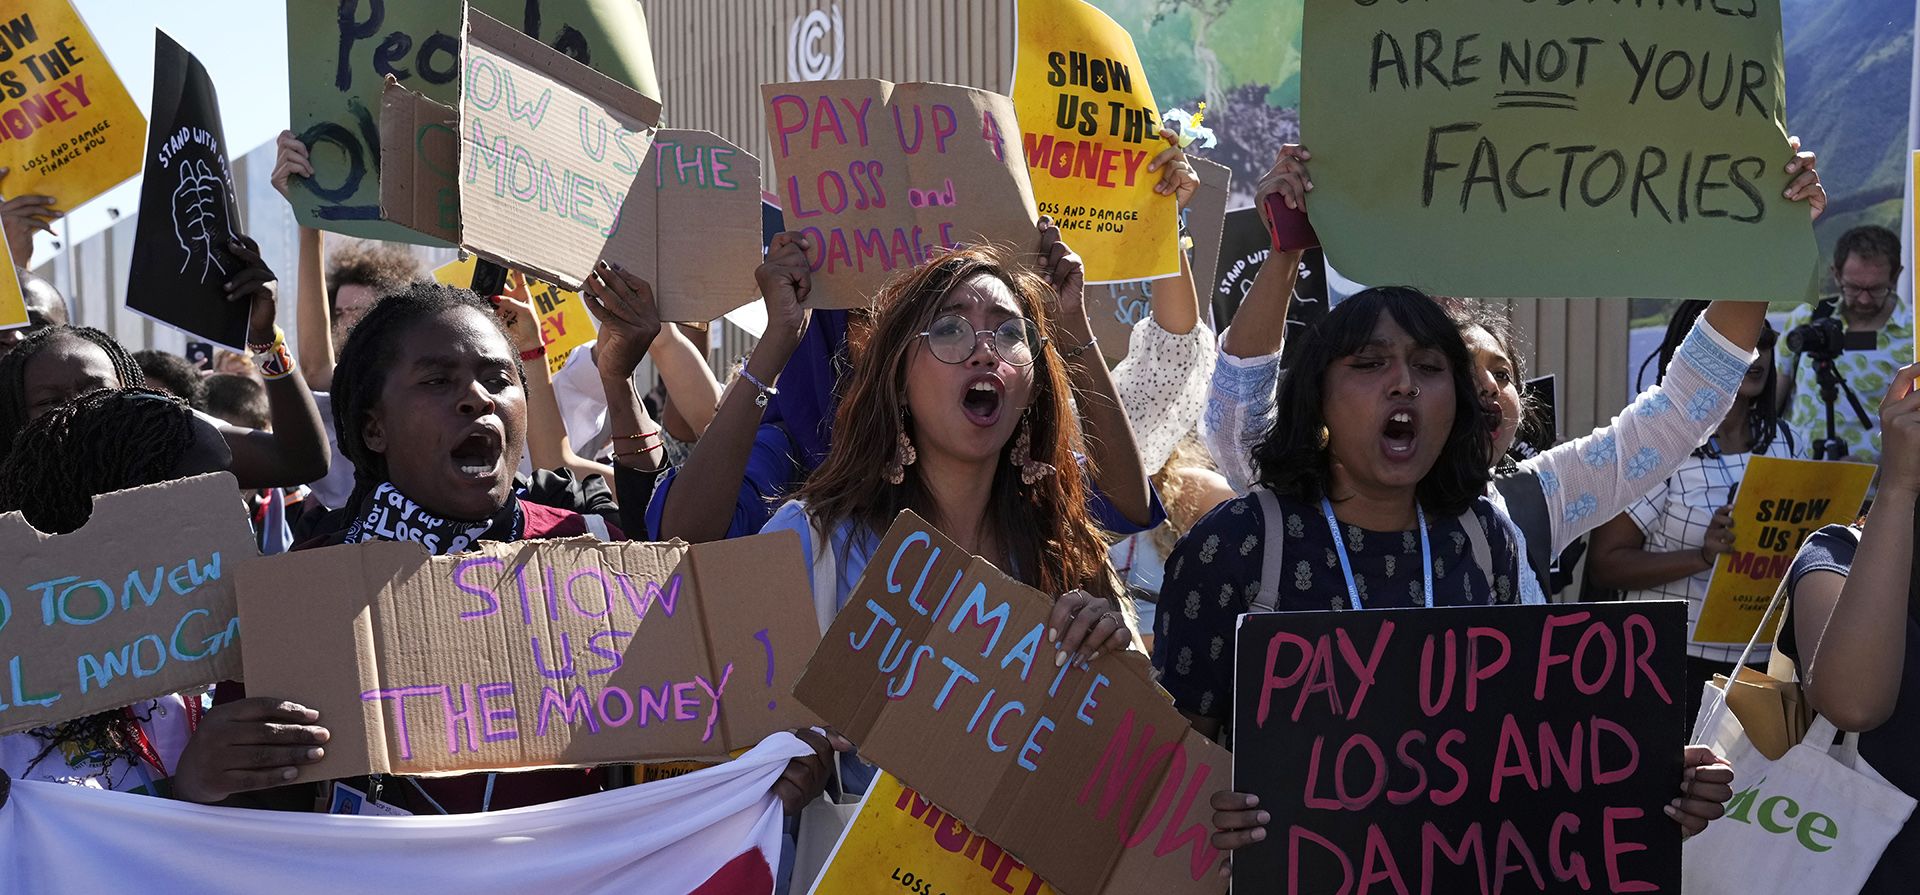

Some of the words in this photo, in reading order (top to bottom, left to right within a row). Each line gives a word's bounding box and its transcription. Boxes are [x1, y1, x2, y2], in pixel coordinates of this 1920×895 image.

[19, 36, 84, 84] THE
[1047, 51, 1132, 94] SHOW
[1369, 29, 1482, 93] ARE
[1500, 37, 1605, 88] NOT
[1619, 38, 1769, 119] YOUR
[771, 94, 872, 158] PAY
[893, 104, 957, 155] UP
[1056, 93, 1099, 136] US
[1107, 101, 1160, 144] THE
[22, 154, 48, 172] LOSS
[51, 144, 69, 158] AND
[71, 120, 111, 146] DAMAGE
[40, 148, 82, 176] FINANCE
[85, 136, 106, 154] NOW
[159, 127, 190, 168] STAND
[193, 127, 217, 154] WITH
[579, 106, 640, 175] US
[651, 141, 738, 190] THE
[1023, 132, 1148, 188] MONEY
[1421, 121, 1766, 224] FACTORIES
[466, 116, 624, 238] MONEY
[787, 160, 886, 218] LOSS
[908, 178, 957, 208] and
[1038, 202, 1059, 214] OSS
[1063, 205, 1086, 217] AND
[1090, 209, 1138, 221] DAMAGE
[1053, 217, 1092, 230] NANCE
[1096, 222, 1124, 233] NOW
[1219, 259, 1246, 295] STAND
[1247, 249, 1270, 265] WIT
[535, 286, 566, 315] HE
[363, 504, 382, 531] for
[375, 507, 441, 556] Loss
[374, 482, 421, 521] Pay
[417, 511, 444, 530] up
[1756, 499, 1831, 524] SHOW
[1727, 551, 1795, 581] MON
[1757, 526, 1791, 552] US
[26, 575, 116, 626] TO
[121, 552, 221, 611] NEW
[453, 556, 682, 625] SHOW
[531, 631, 633, 679] US
[887, 531, 1110, 726] CLIMATE
[77, 634, 167, 694] AND
[849, 599, 1056, 772] JUSTICE
[1257, 619, 1395, 727] PAY
[1420, 627, 1512, 718] UP
[1534, 611, 1673, 704] FOR
[360, 682, 518, 760] THE
[536, 662, 734, 744] MONEY
[1304, 729, 1469, 811] LOSS
[1489, 714, 1640, 803] AND
[1076, 708, 1220, 882] NOW
[1288, 805, 1660, 895] DAMAGE
[891, 867, 933, 895] LOSS
